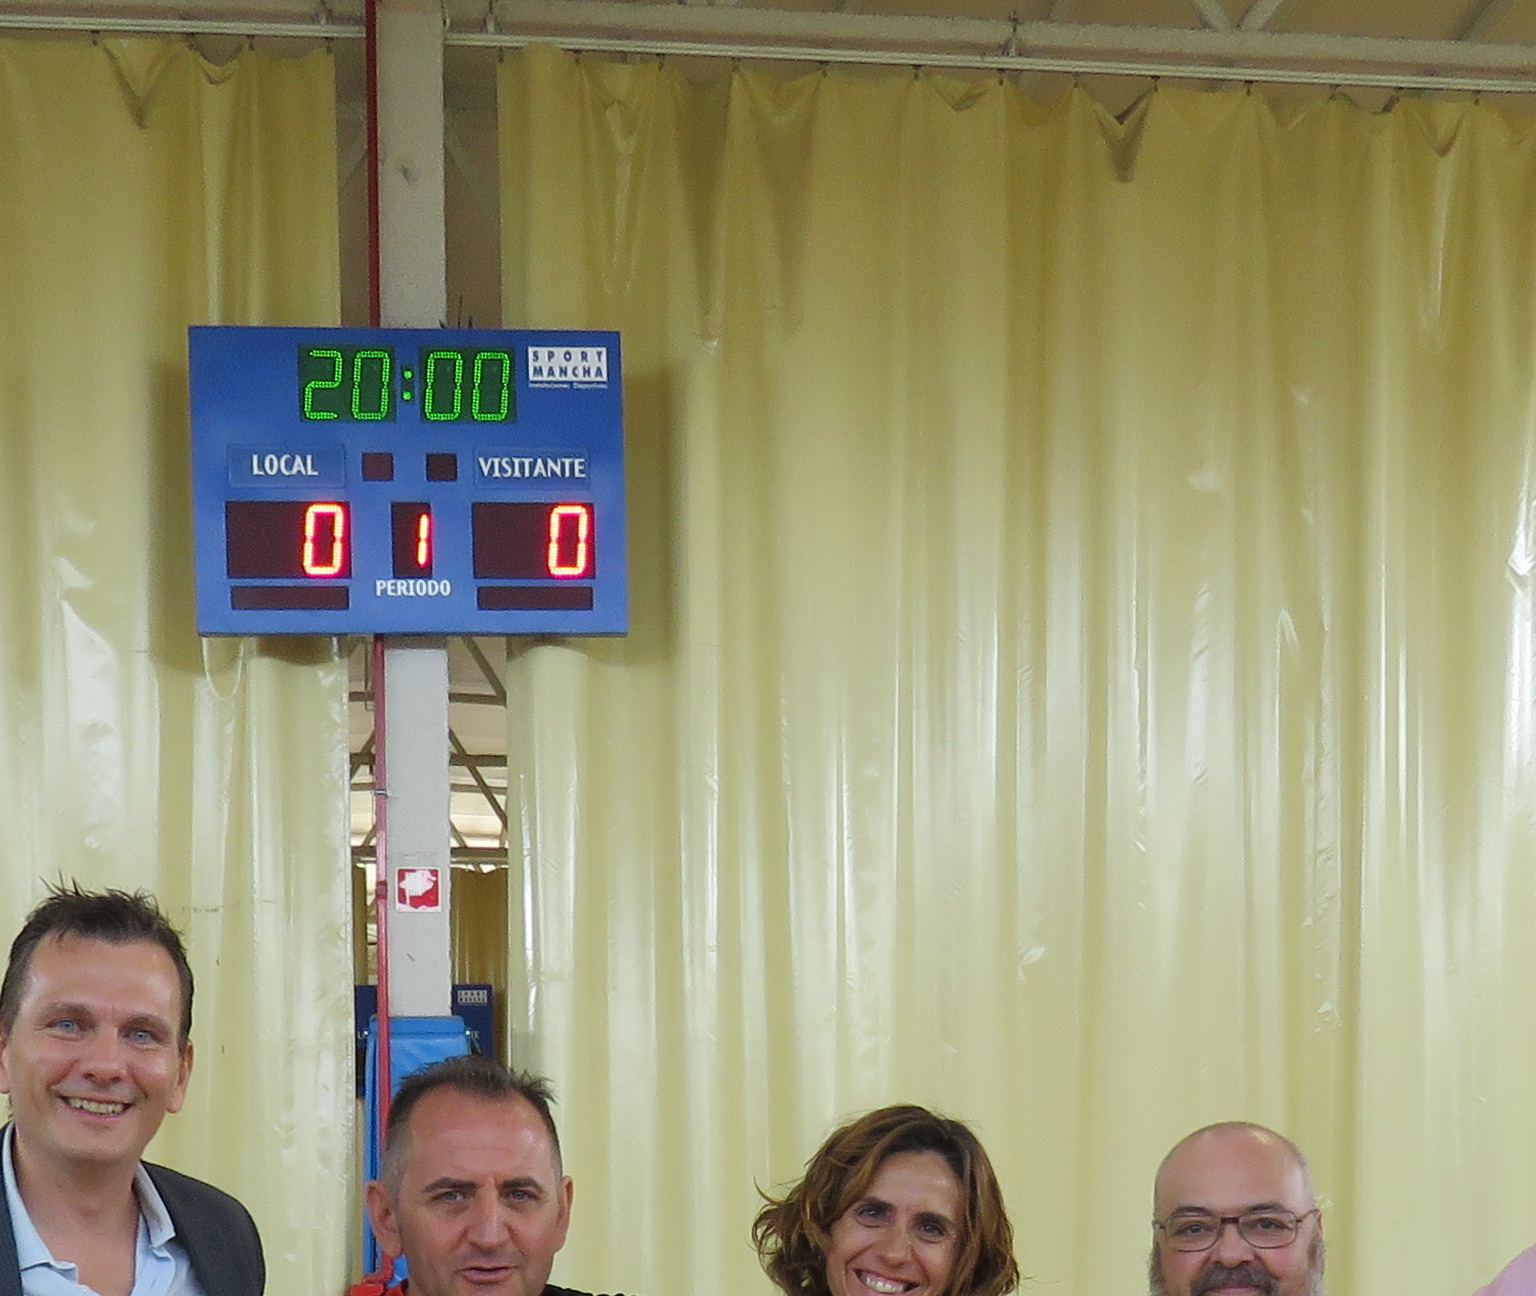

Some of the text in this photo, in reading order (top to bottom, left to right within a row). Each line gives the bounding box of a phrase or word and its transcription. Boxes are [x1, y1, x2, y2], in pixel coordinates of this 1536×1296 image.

[532, 350, 603, 362] SPORT
[532, 365, 604, 379] MANCHA
[302, 349, 511, 421] 20:00
[251, 453, 319, 476] LOCAL
[477, 456, 587, 478] VISITANTE
[303, 503, 345, 576] 0
[416, 513, 431, 569] 1
[548, 505, 589, 577] 0
[375, 579, 452, 597] PERIODO
